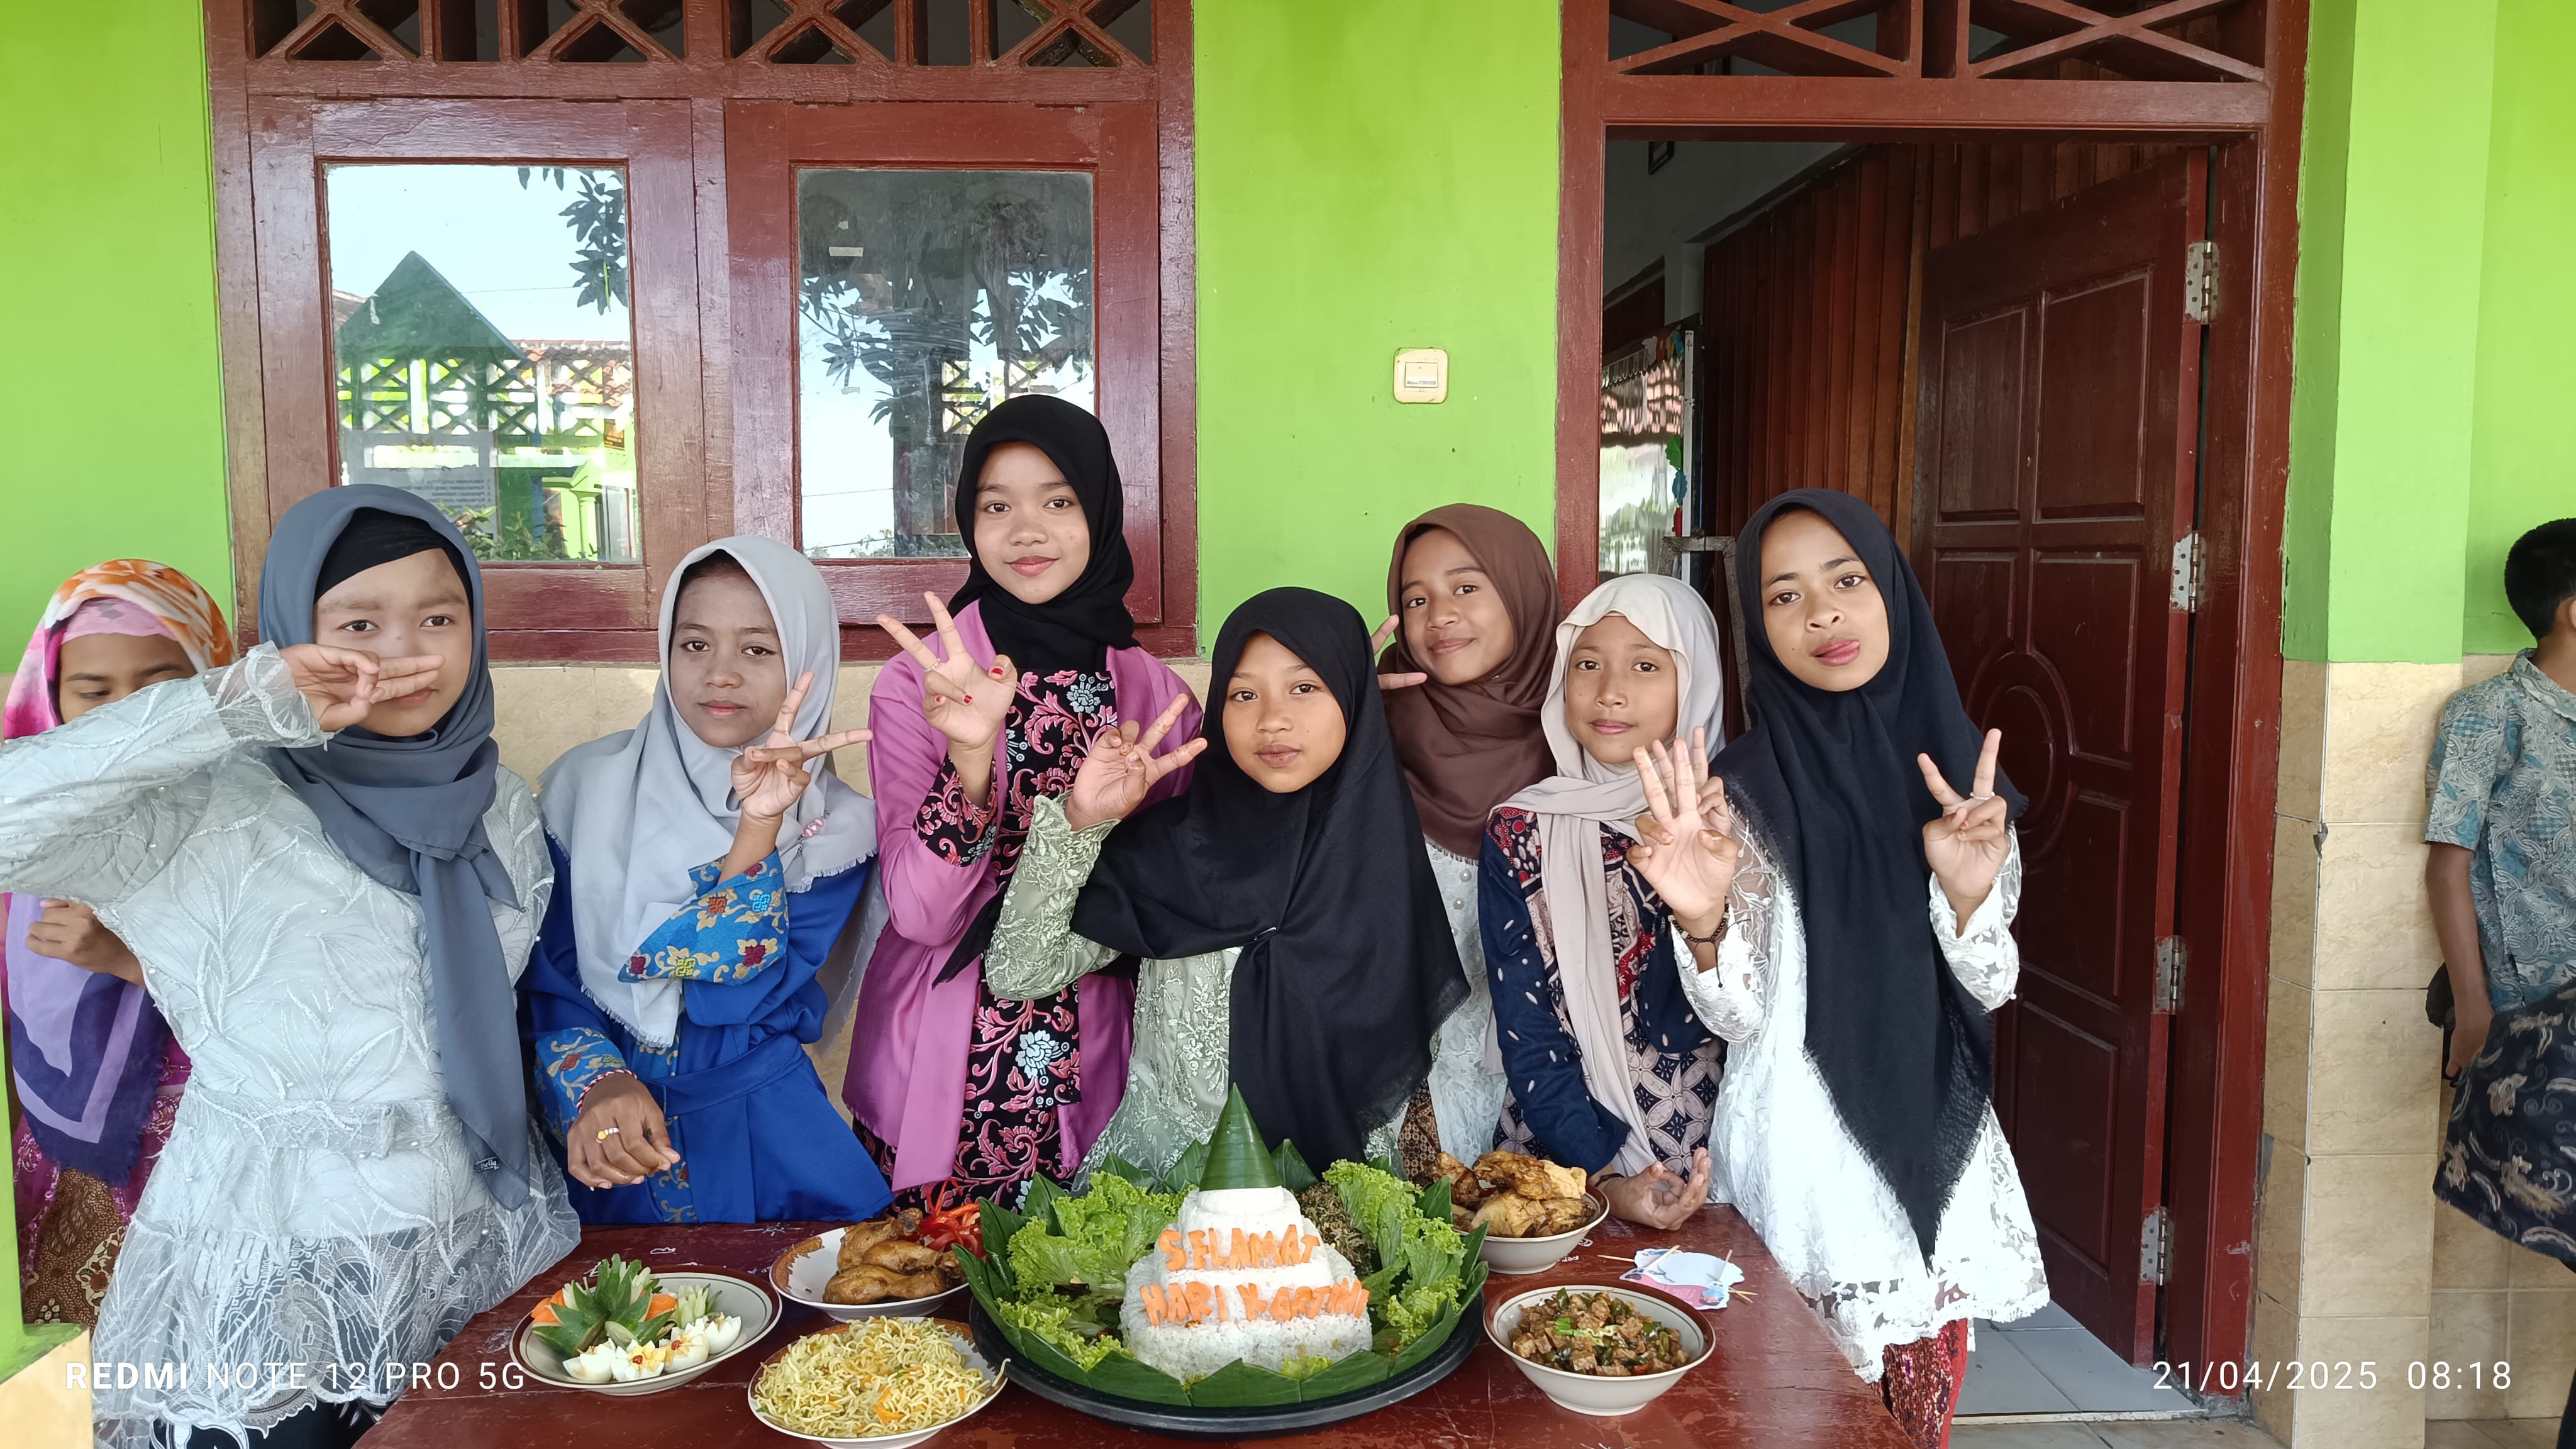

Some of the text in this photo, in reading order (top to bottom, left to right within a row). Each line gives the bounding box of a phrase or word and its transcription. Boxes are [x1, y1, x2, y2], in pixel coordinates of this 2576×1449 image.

[1158, 1224, 1320, 1272] SELAMAT
[1140, 1278, 1370, 1326] HARI KARTINI
